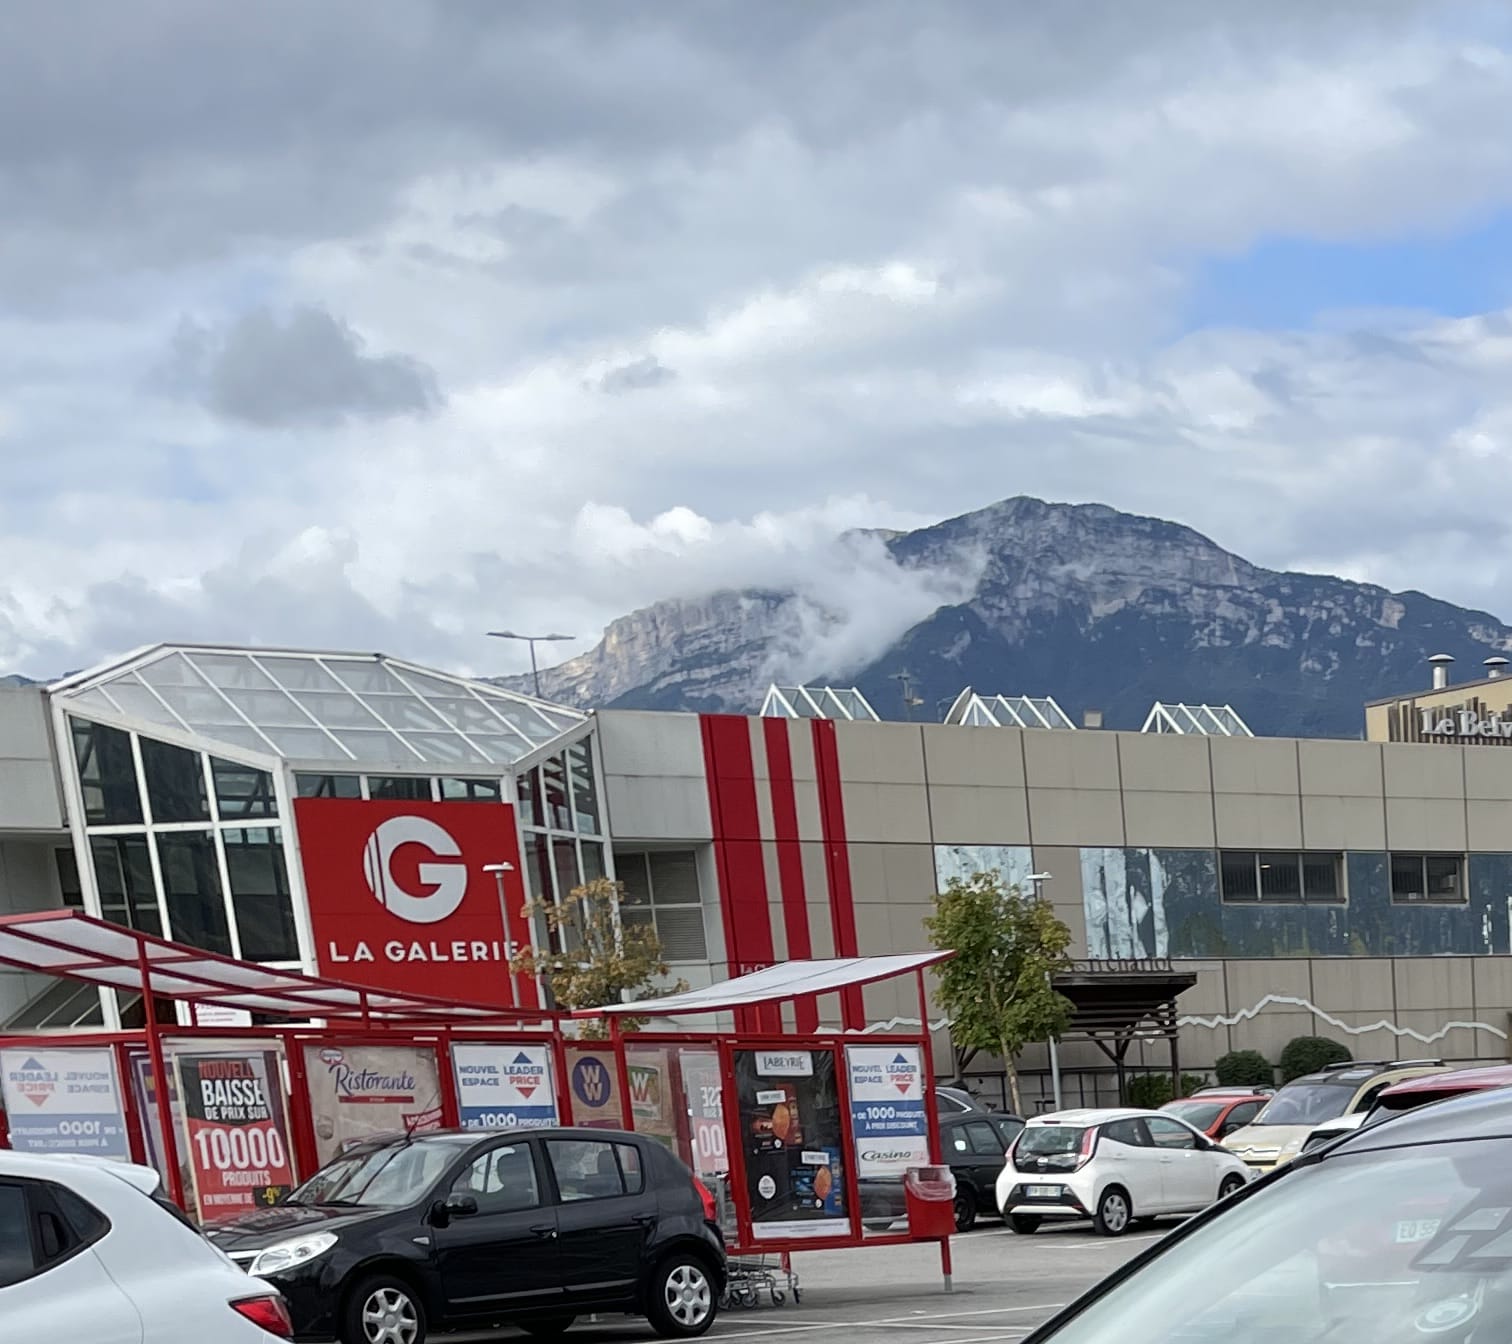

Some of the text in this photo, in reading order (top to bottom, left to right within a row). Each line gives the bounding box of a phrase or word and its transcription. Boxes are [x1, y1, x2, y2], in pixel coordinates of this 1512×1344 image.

[1421, 708, 1456, 735] Le
[363, 815, 468, 924] G
[329, 941, 375, 962] LA
[459, 1066, 499, 1074] NOUVEL
[504, 1066, 543, 1075] LEADER
[886, 1065, 917, 1073] LEADER
[328, 1063, 416, 1095] Ristorante
[462, 1078, 499, 1086] ESPACE
[509, 1076, 541, 1085] PRICE
[890, 1074, 914, 1082] PRICE
[201, 1080, 265, 1106] BAISSE
[205, 1106, 268, 1120] DE PRIX SUR
[866, 1106, 895, 1119] 1000
[480, 1113, 517, 1127] 1000
[194, 1128, 286, 1170] 10000
[861, 1150, 911, 1161] Casino
[222, 1170, 272, 1187] PRODUITS
